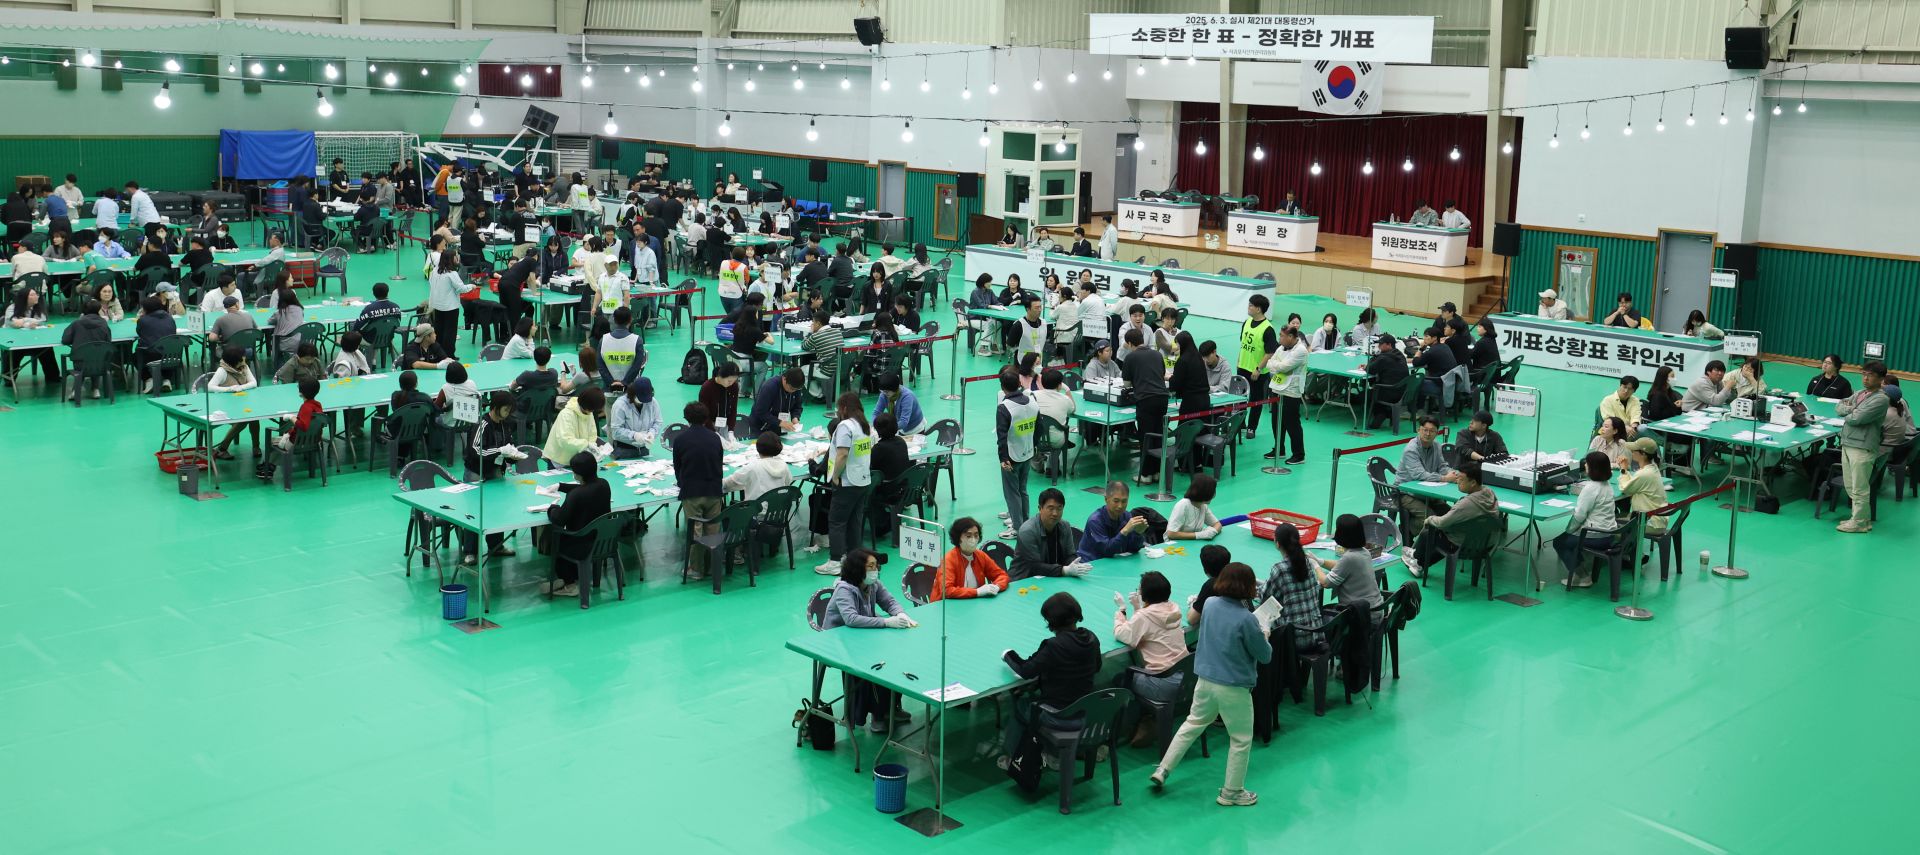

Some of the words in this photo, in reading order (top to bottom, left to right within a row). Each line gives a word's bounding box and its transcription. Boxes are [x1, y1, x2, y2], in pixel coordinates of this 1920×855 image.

[1185, 16, 1207, 25] 2025.
[1210, 16, 1217, 25] 6.
[1219, 16, 1227, 25] 3.
[1230, 16, 1245, 25] 실시
[1247, 16, 1272, 25] 제21대
[1274, 17, 1315, 26] 대통령선거
[1131, 27, 1186, 43] 소중한
[1192, 27, 1210, 44] 한
[1216, 28, 1235, 44] 표
[1257, 28, 1323, 48] 정확한
[1330, 30, 1375, 49] 개표
[1380, 236, 1437, 252] 위원장보조석
[1502, 329, 1609, 361] 개표상황표
[1616, 343, 1685, 373] 확인석
[904, 536, 936, 553] 개함부
